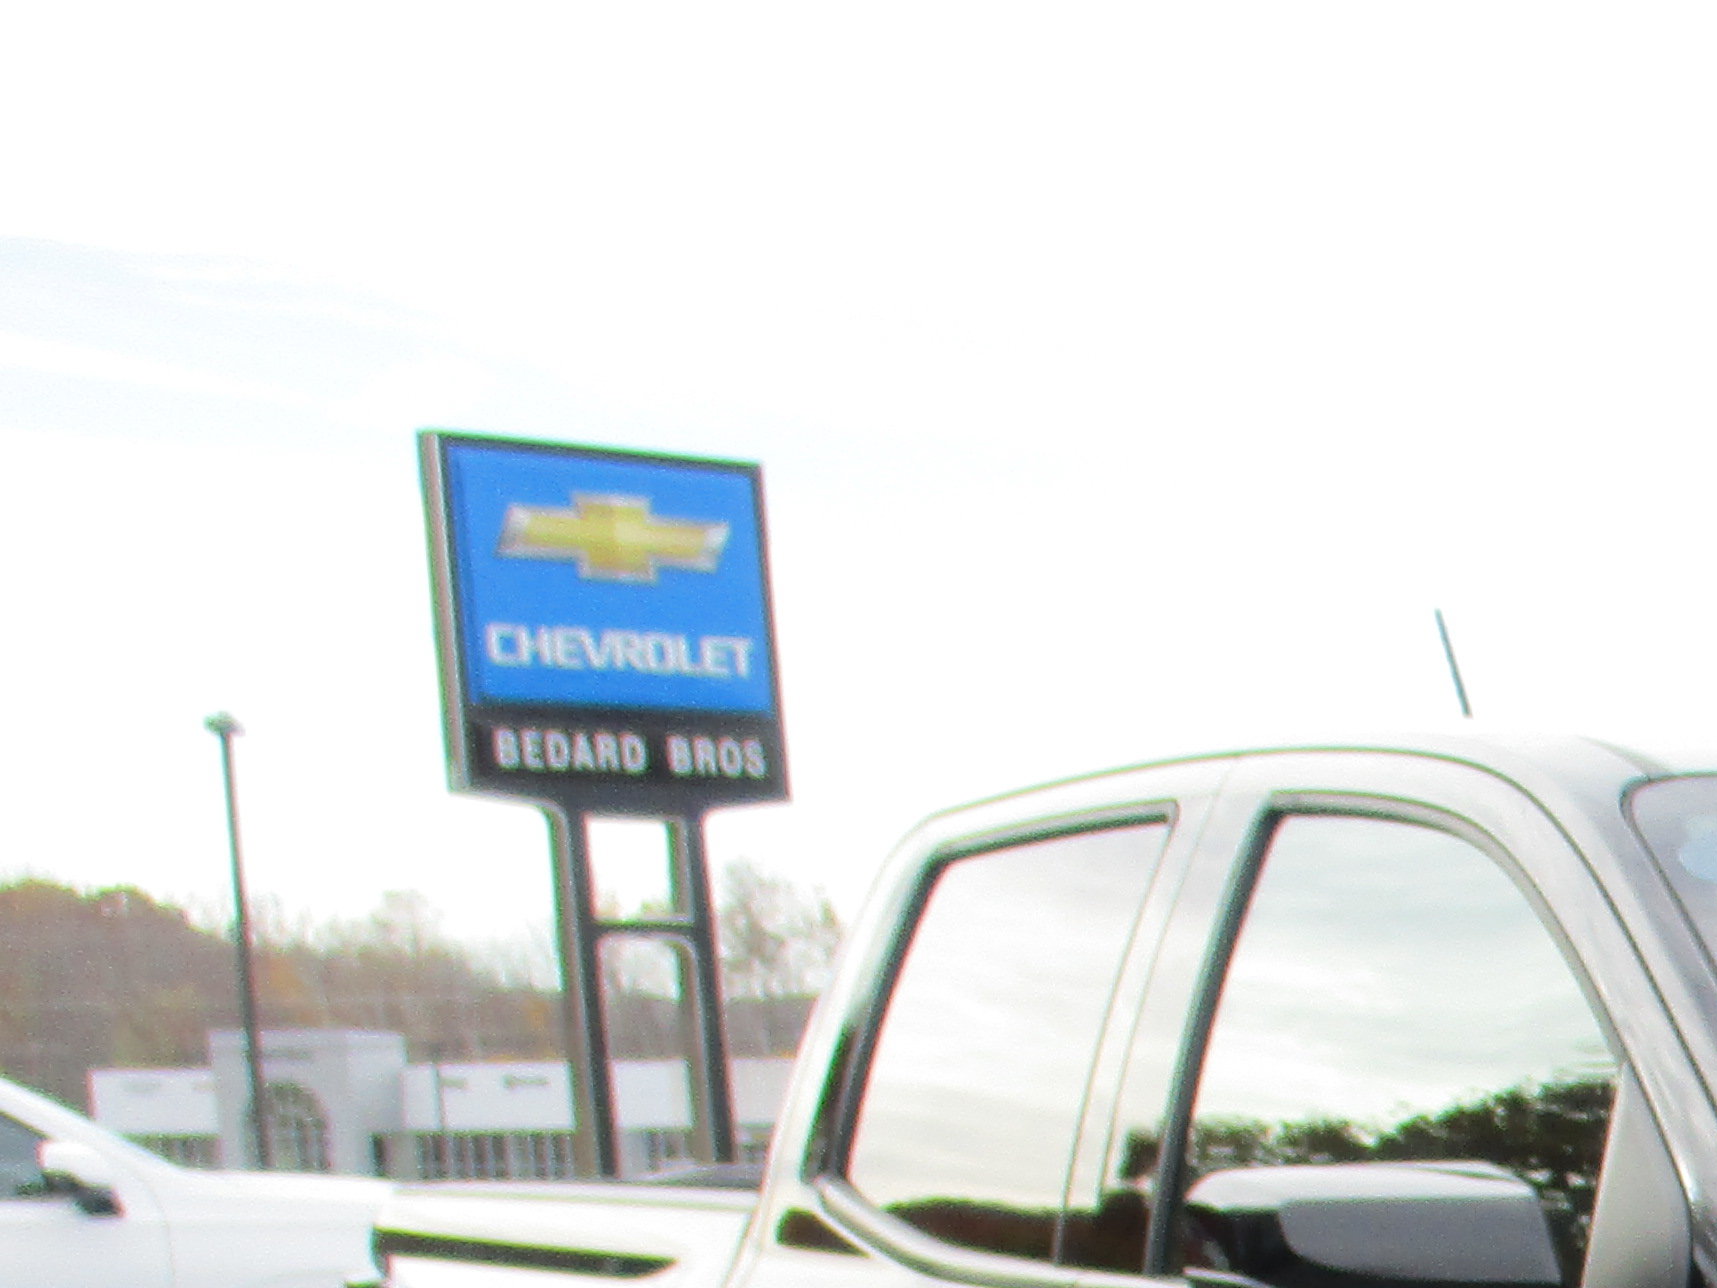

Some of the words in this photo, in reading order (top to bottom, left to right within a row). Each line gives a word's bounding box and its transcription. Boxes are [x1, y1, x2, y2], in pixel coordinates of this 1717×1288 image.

[485, 622, 755, 679] CHEVROLET
[493, 727, 649, 775] BEDARD
[666, 732, 768, 780] BROS
